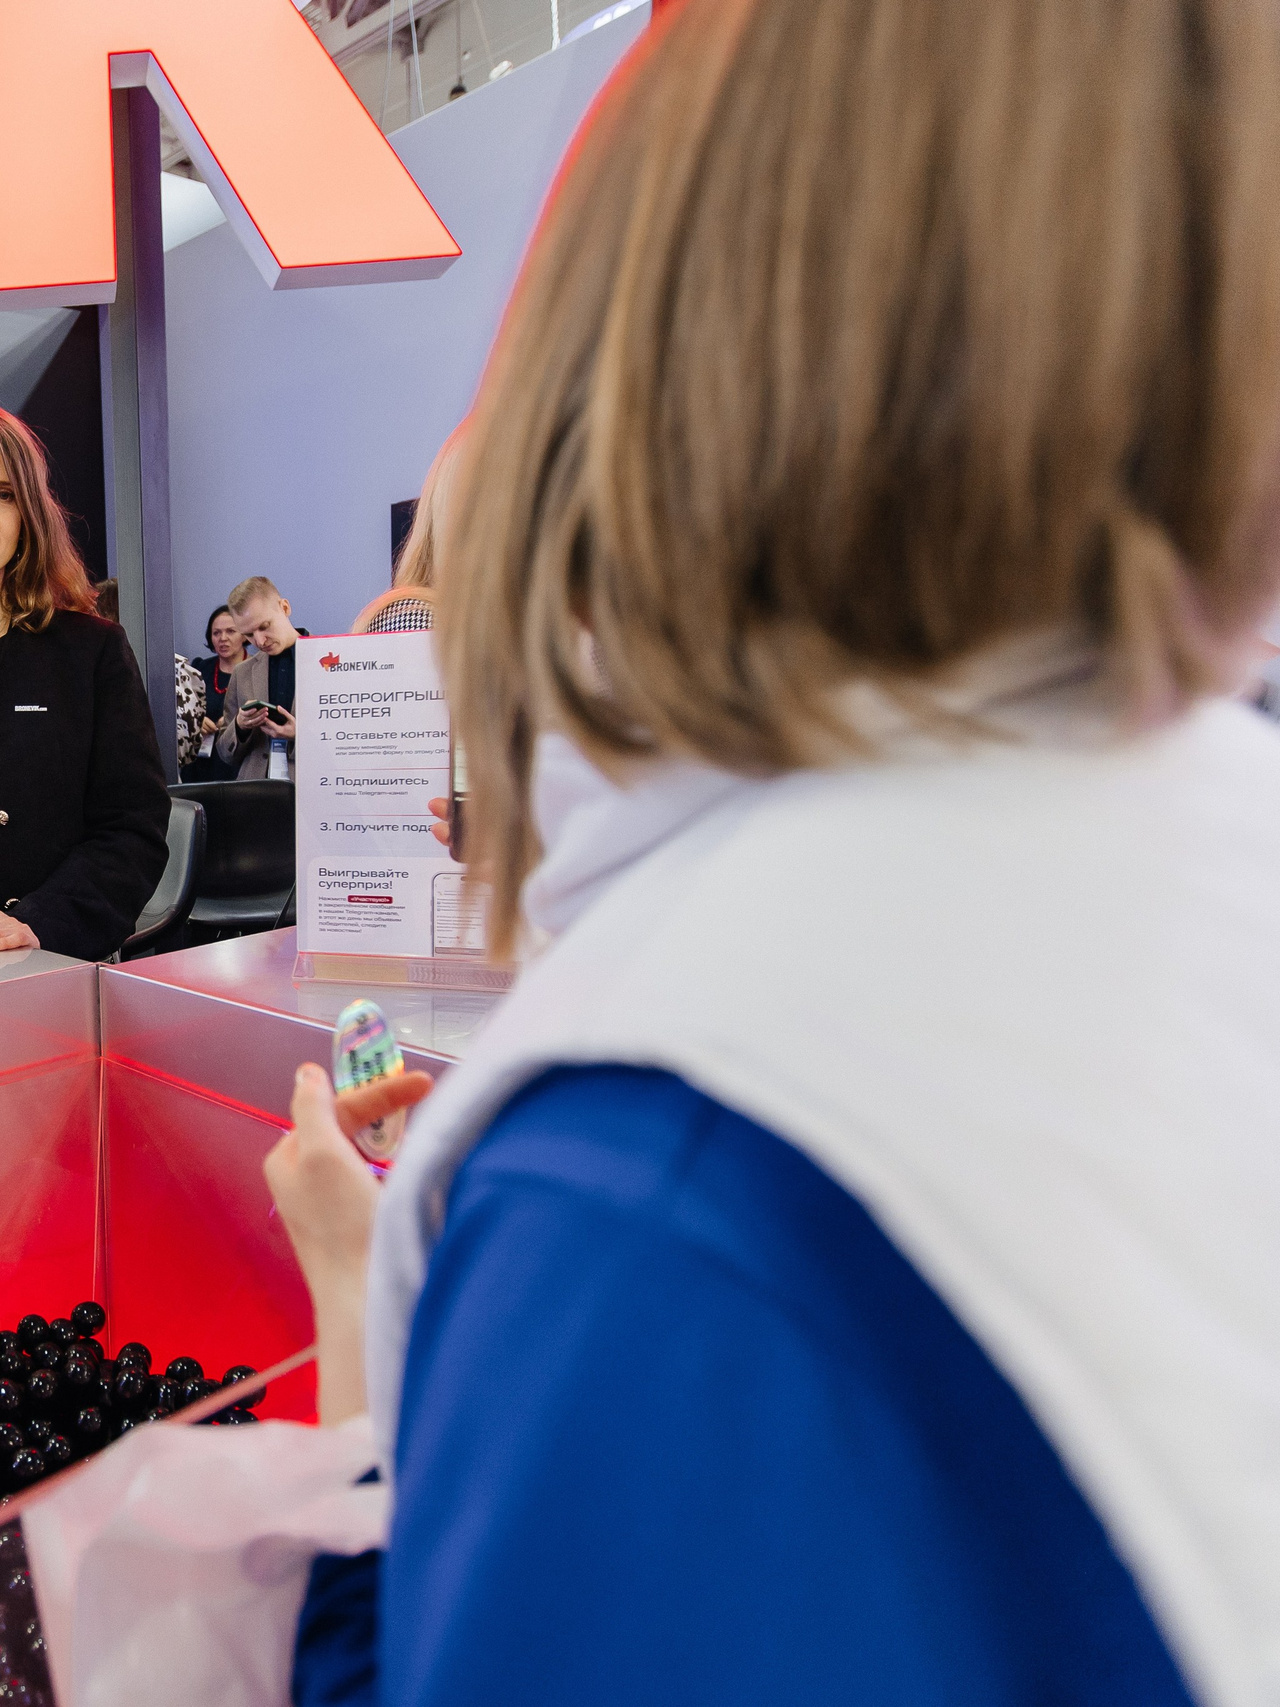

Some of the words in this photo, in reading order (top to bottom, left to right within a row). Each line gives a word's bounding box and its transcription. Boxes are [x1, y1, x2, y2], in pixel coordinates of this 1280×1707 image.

[330, 661, 395, 673] BRONEVIK.com
[319, 690, 447, 705] БЕСПРОИГРЫШ
[318, 707, 391, 720] ЛОТЕРЕЯ
[320, 732, 332, 741] 1.
[336, 731, 398, 741] Оставьте
[401, 730, 449, 739] контак
[320, 777, 332, 786] 2.
[335, 777, 429, 787] Подпишитесь
[320, 823, 332, 832] 3.
[335, 822, 399, 833] Получите
[402, 823, 433, 833] пода
[318, 867, 410, 880] Выигрывайте
[318, 880, 393, 891] суперприз!
